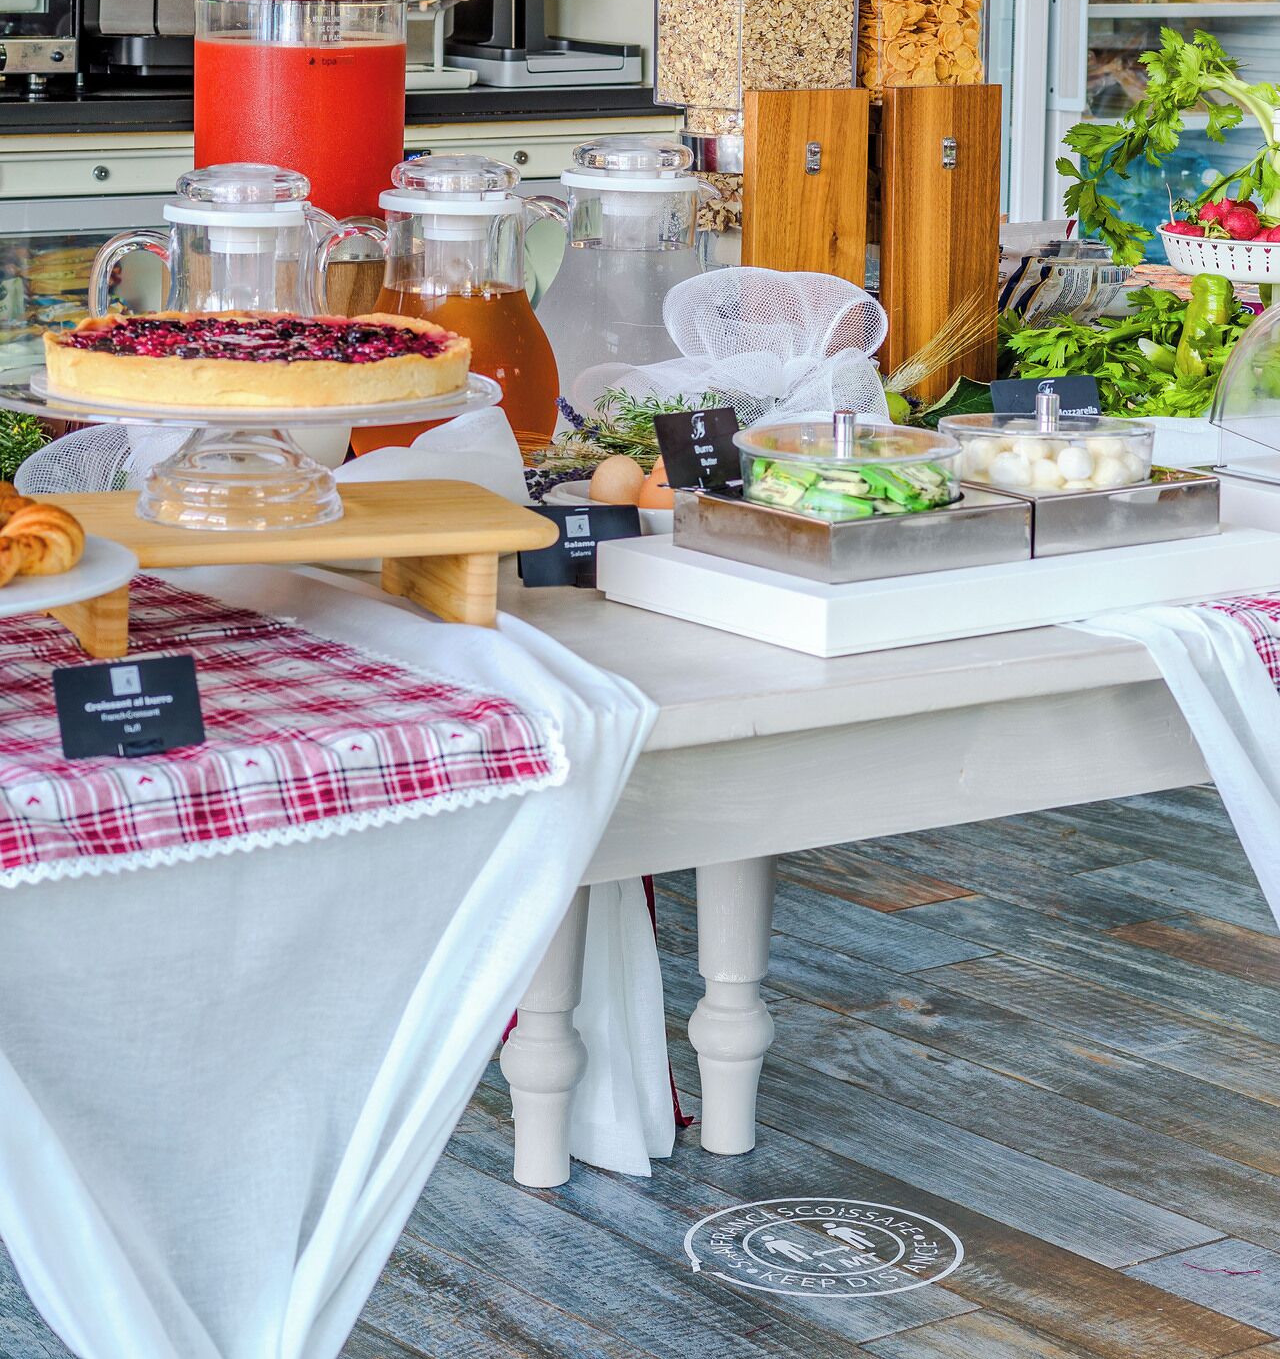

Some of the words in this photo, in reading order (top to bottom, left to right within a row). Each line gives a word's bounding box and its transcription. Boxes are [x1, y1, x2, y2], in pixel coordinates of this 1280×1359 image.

[694, 445, 713, 454] Burro
[860, 1211, 923, 1235] SAFE
[760, 1271, 835, 1288] KEEP
[846, 1241, 938, 1288] DISTANCE
